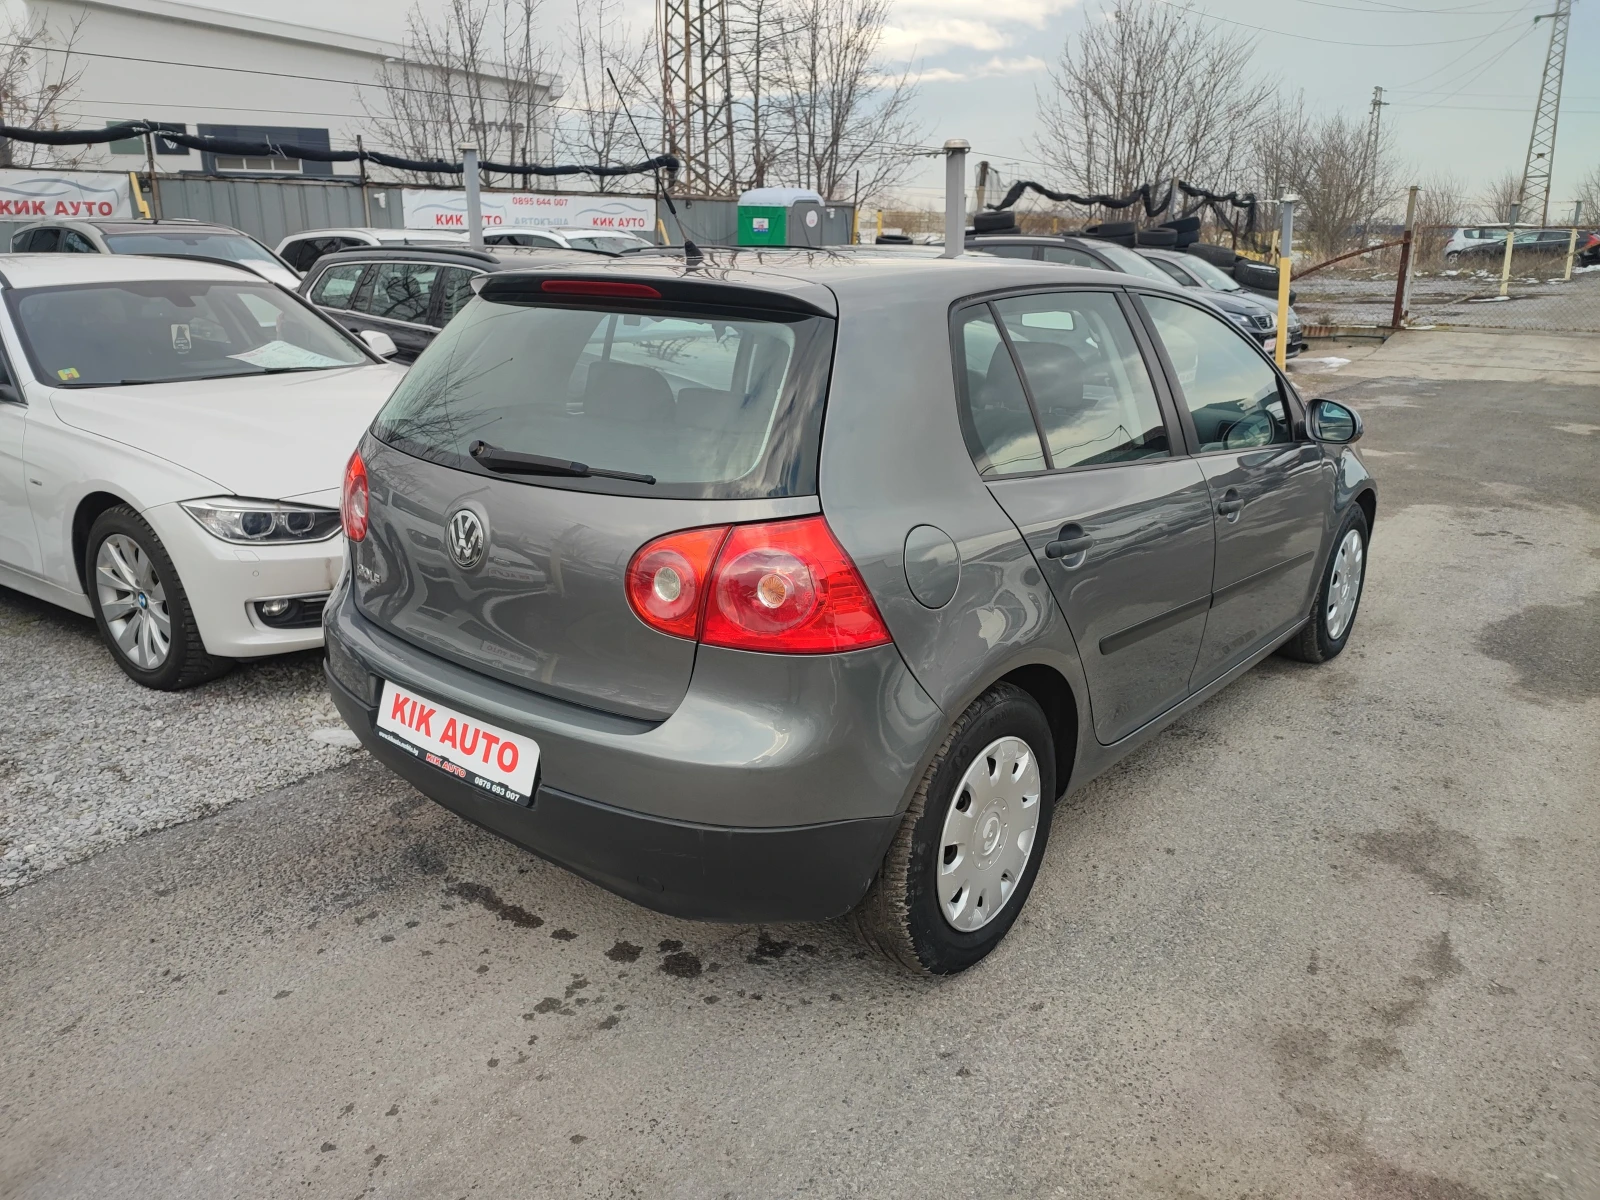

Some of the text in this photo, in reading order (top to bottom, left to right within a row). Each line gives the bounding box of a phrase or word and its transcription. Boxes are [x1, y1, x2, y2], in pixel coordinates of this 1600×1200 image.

[0, 199, 113, 216] КИК АУТО
[512, 196, 568, 207] 0895 644 007
[435, 213, 463, 226] КИК
[592, 217, 645, 228] КИК АУТО
[391, 692, 437, 738] KIK
[439, 717, 519, 774] AUTO
[425, 752, 466, 778] KIK AUTO
[474, 776, 520, 802] 0878 693 007
